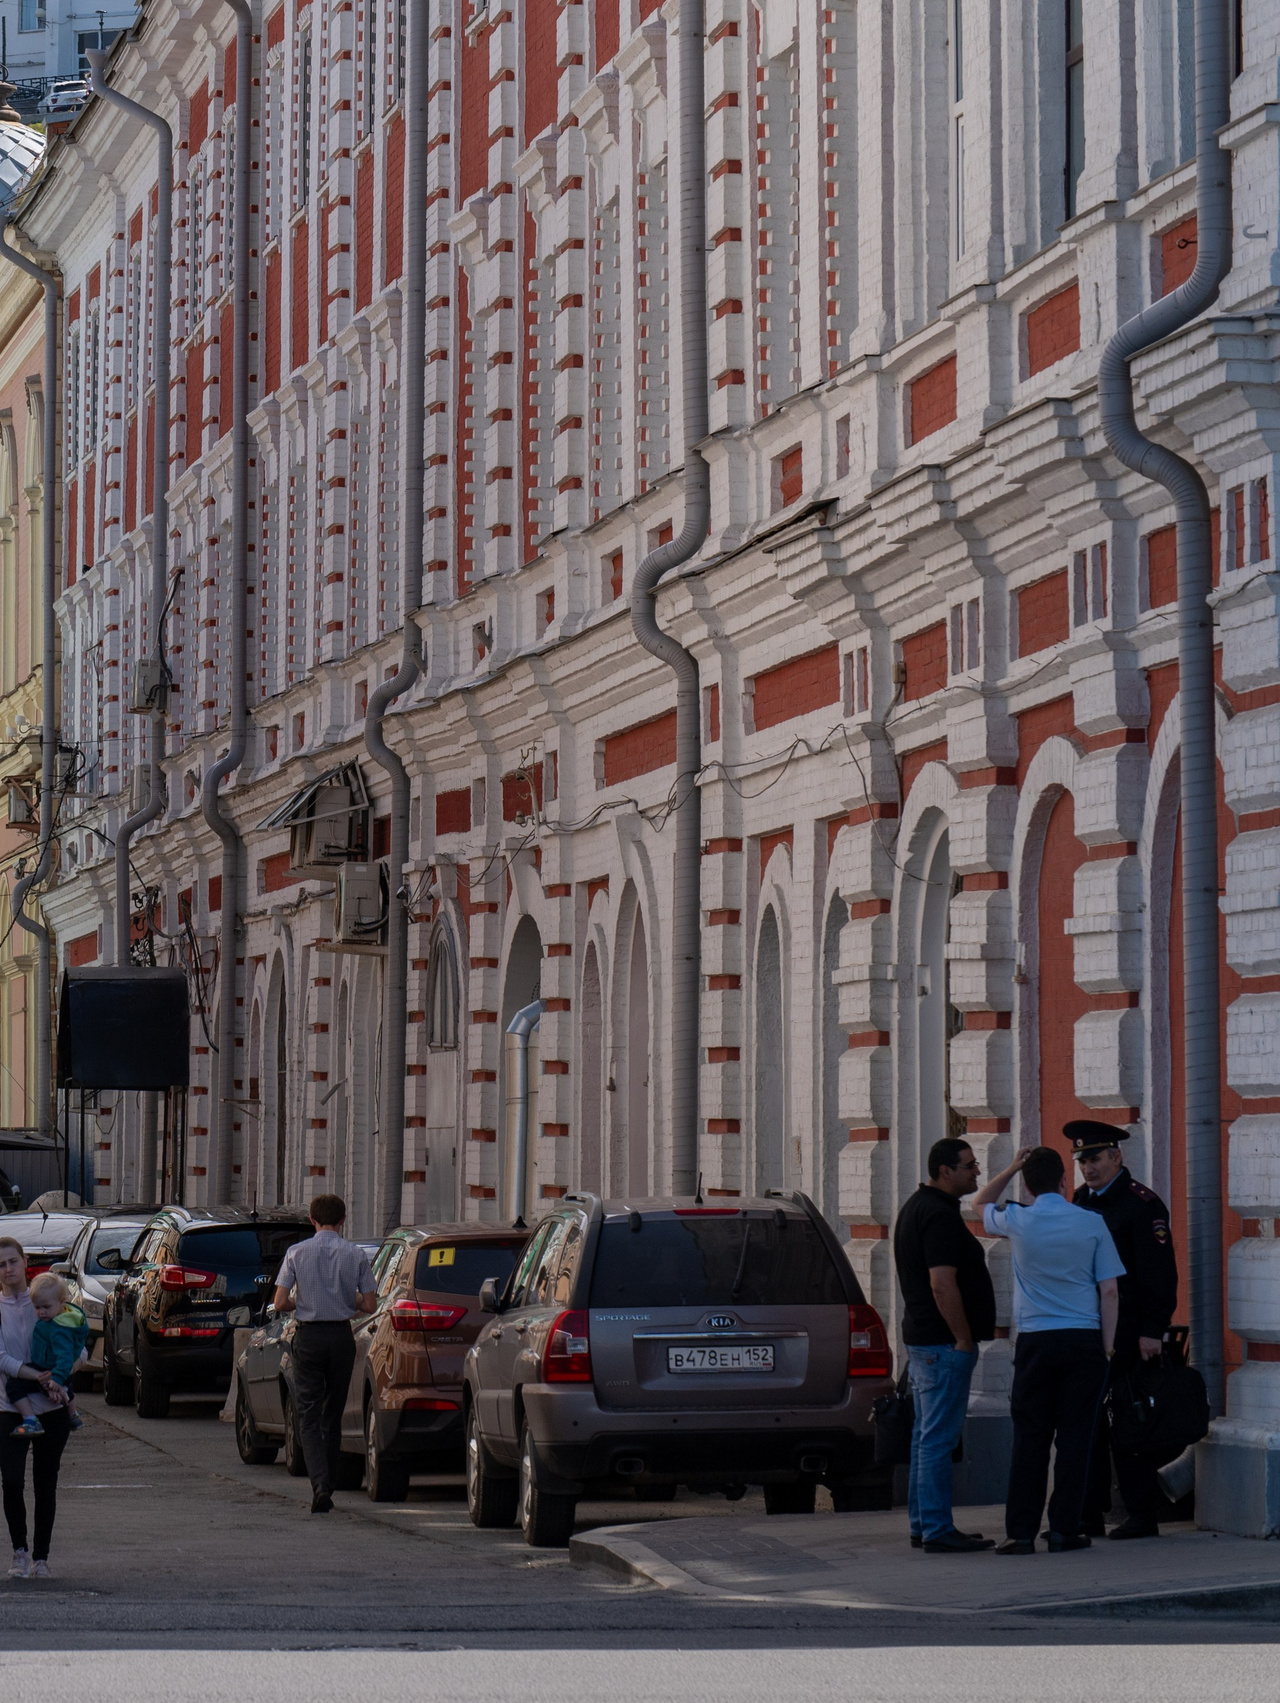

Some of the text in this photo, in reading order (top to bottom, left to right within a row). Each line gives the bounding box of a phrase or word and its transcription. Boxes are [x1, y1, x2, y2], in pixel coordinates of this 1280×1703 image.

[711, 1316, 732, 1327] KIA
[674, 1348, 770, 1367] В478ЕН 152
